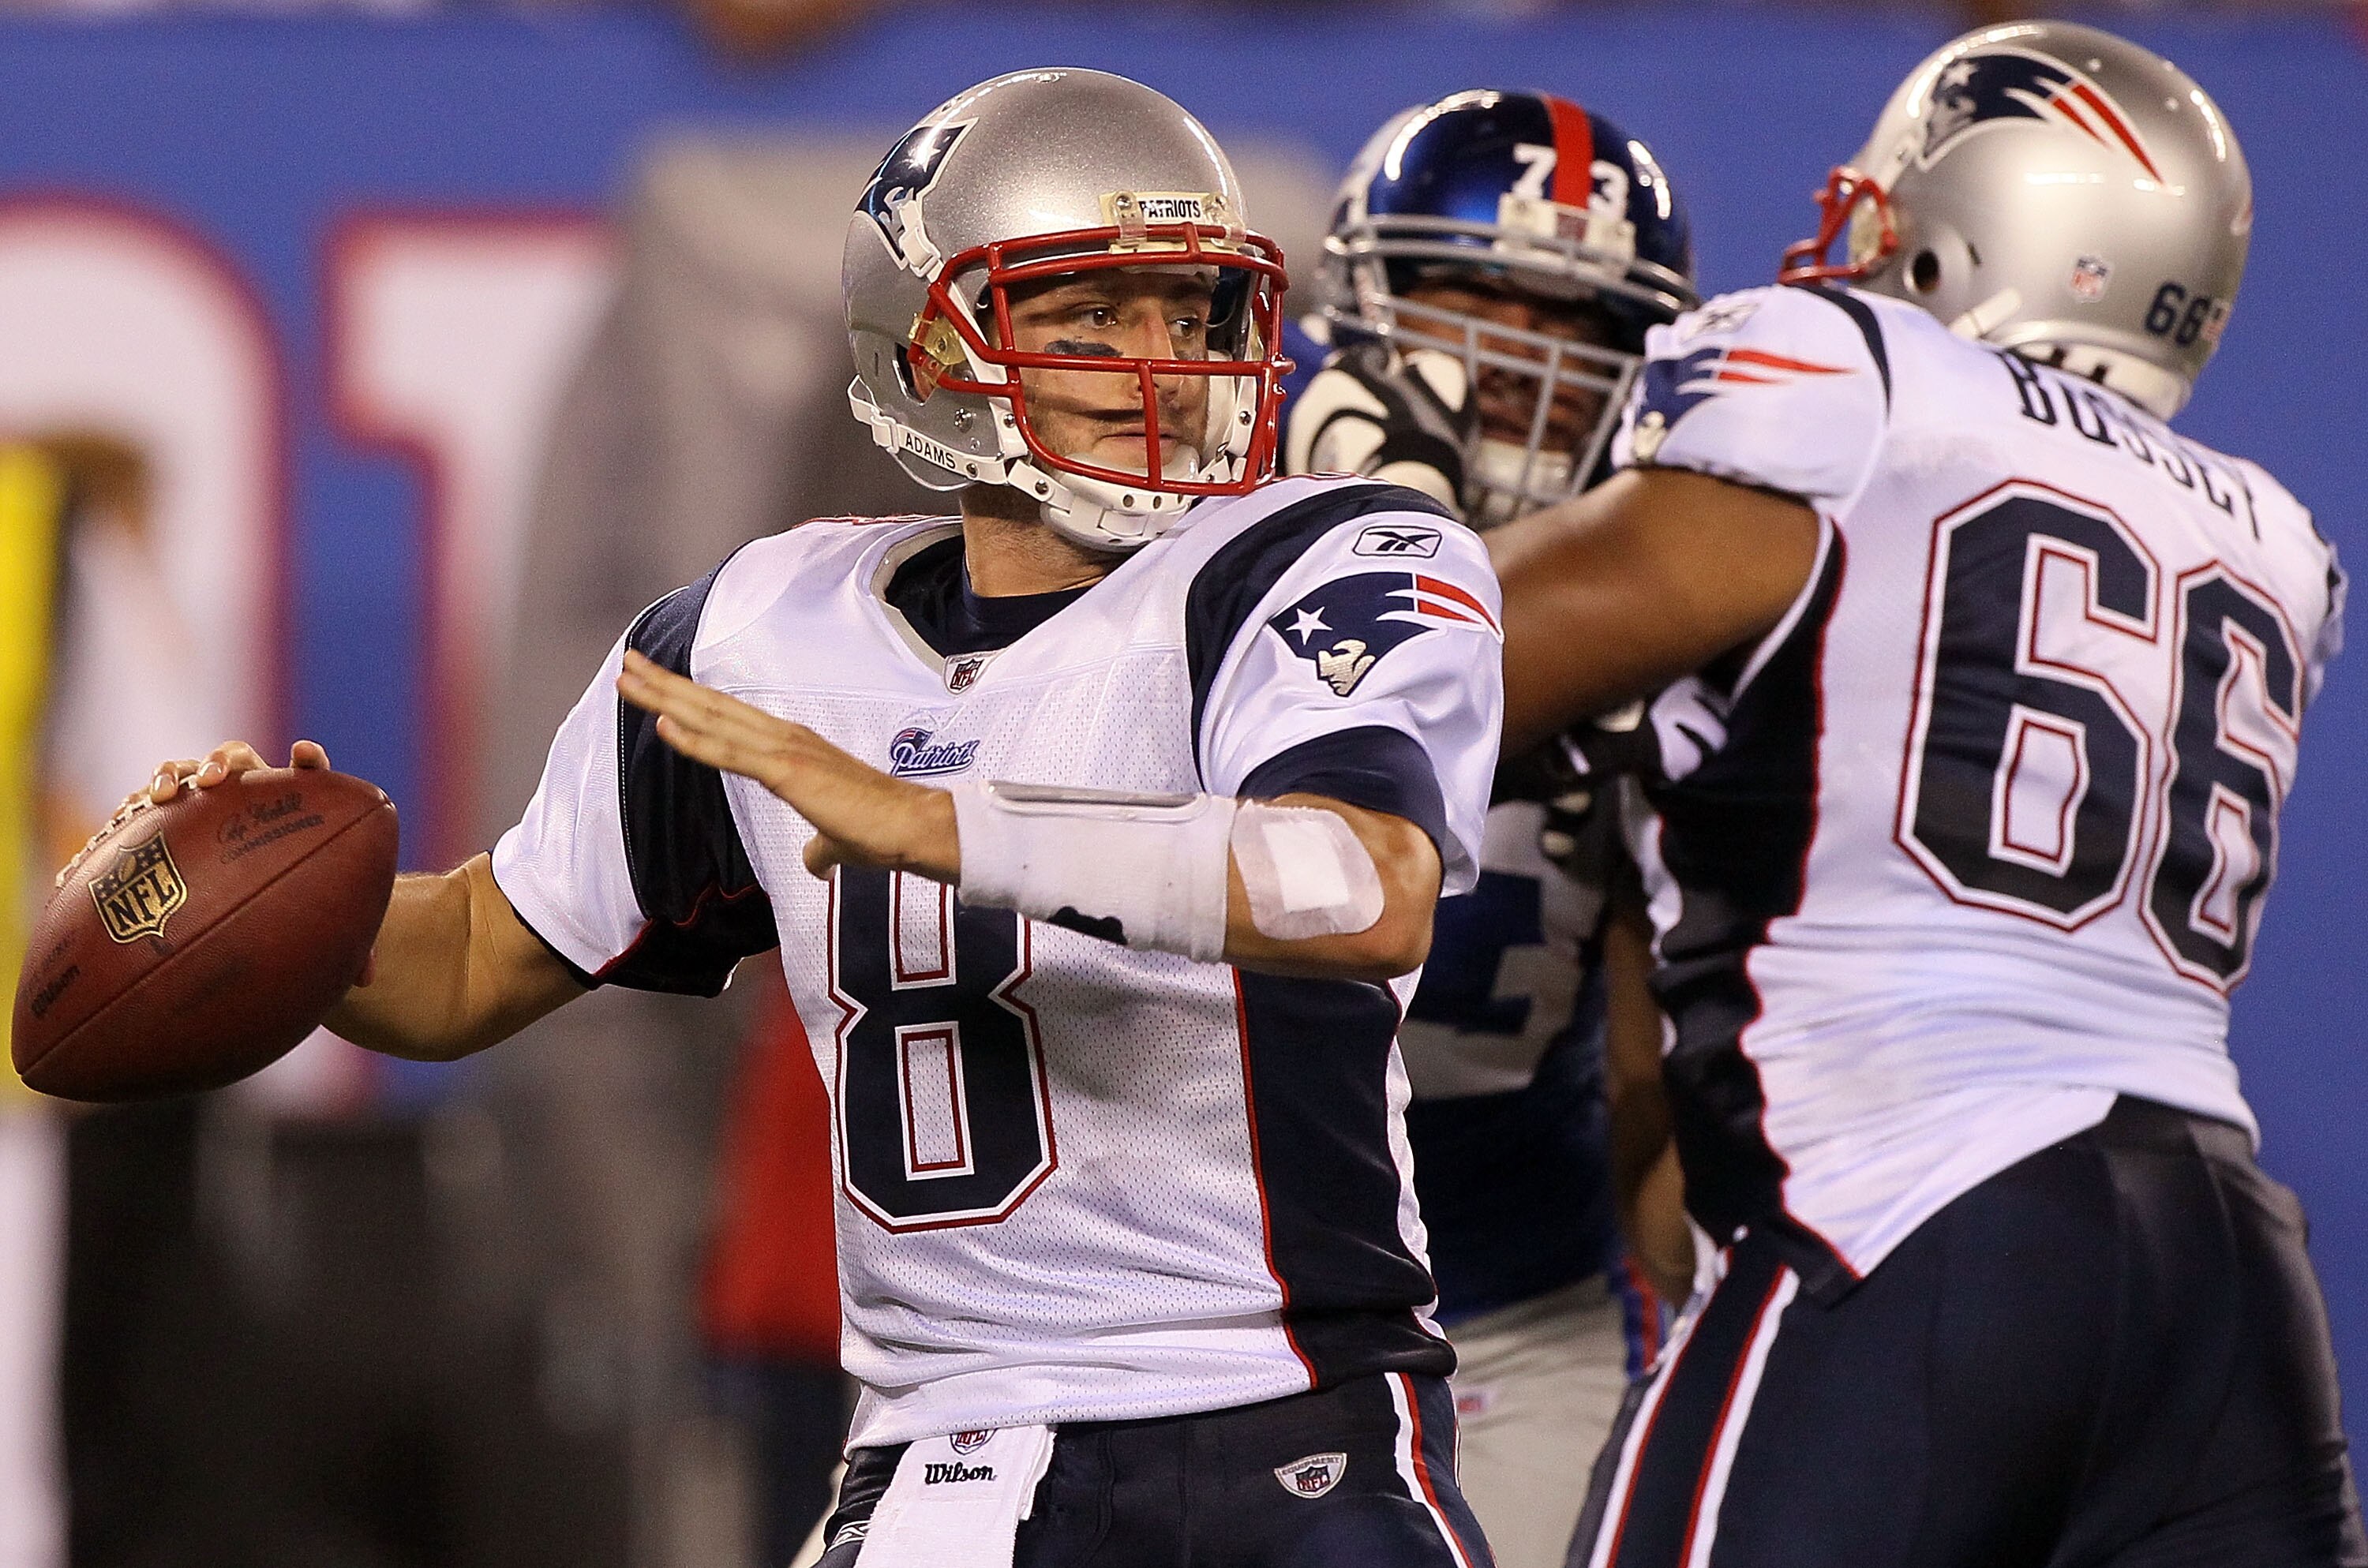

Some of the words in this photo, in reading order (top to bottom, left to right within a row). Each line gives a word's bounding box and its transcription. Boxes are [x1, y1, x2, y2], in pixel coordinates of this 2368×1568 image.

[1139, 199, 1201, 219] PATRIOTS
[1513, 141, 1629, 222] 73
[2144, 280, 2211, 346] 66
[905, 432, 956, 470] ADAMS
[890, 739, 980, 777] Patriots
[1892, 477, 2306, 998] 66
[107, 869, 176, 932] NFL
[827, 863, 1058, 1235] 8
[924, 1461, 996, 1485] Wilson
